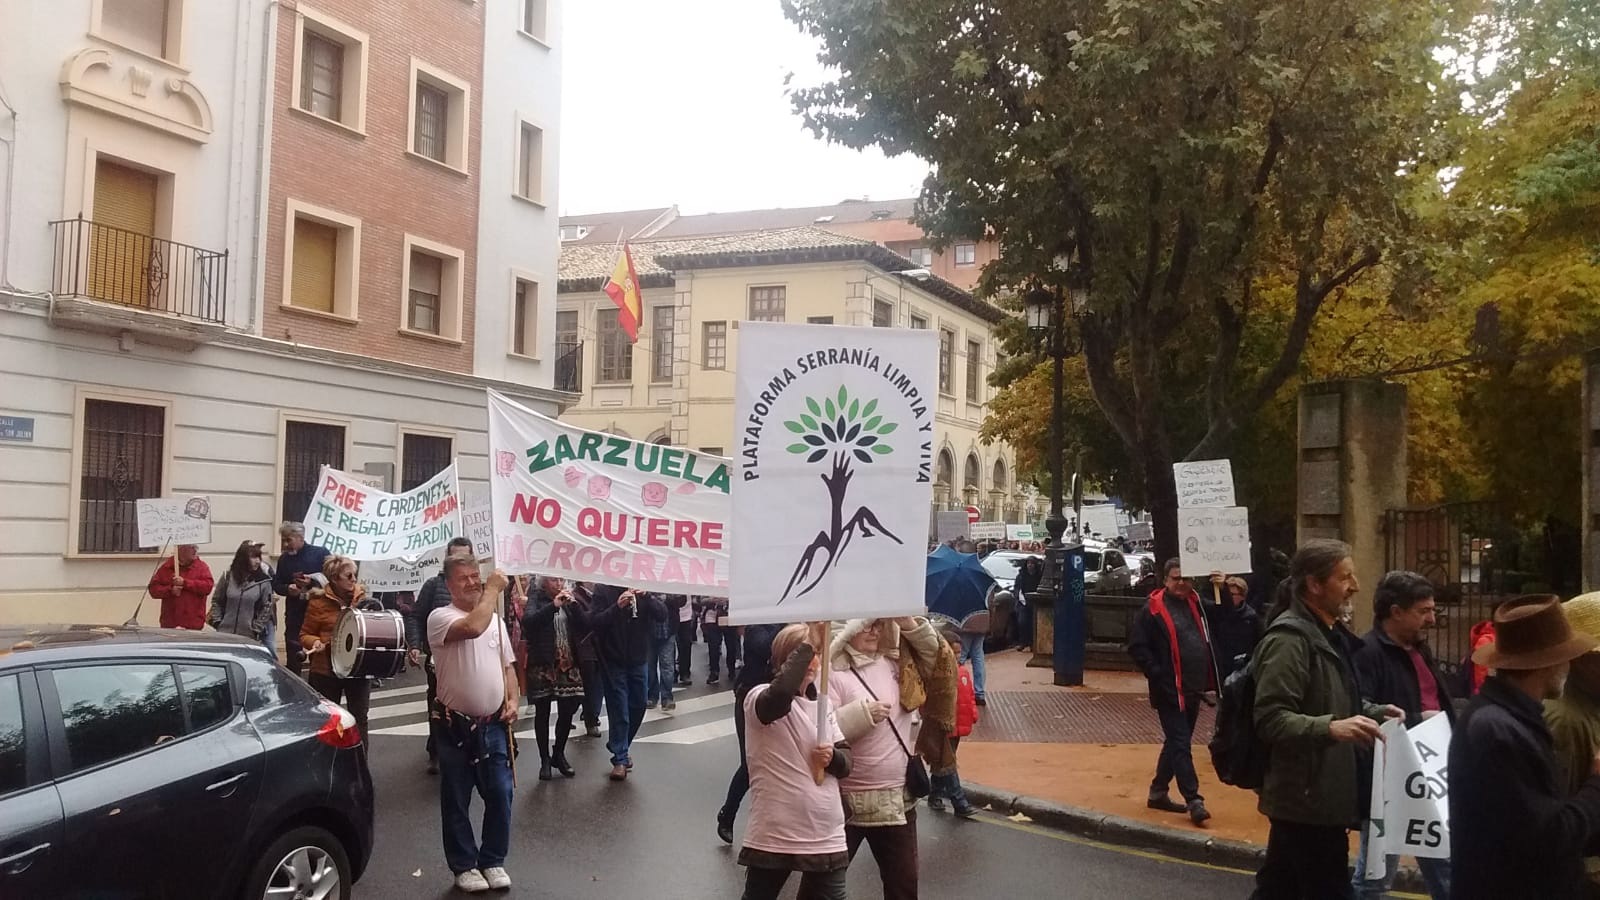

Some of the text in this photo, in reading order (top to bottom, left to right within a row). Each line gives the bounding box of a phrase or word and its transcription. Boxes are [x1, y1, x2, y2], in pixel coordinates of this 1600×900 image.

[743, 348, 932, 483] PLATAFORMA SERRANÍA LIMPIA Y VIVA
[526, 432, 731, 495] ZARZUELA
[317, 501, 335, 524] TE
[338, 511, 396, 536] REGALA
[403, 515, 417, 531] EL
[510, 493, 723, 549] NO QUIERE
[311, 520, 454, 555] PARA TU JARDÍN
[390, 557, 439, 573] PLAORMA
[1073, 554, 1083, 568] P
[1415, 741, 1439, 763] A
[1405, 818, 1442, 848] ES
